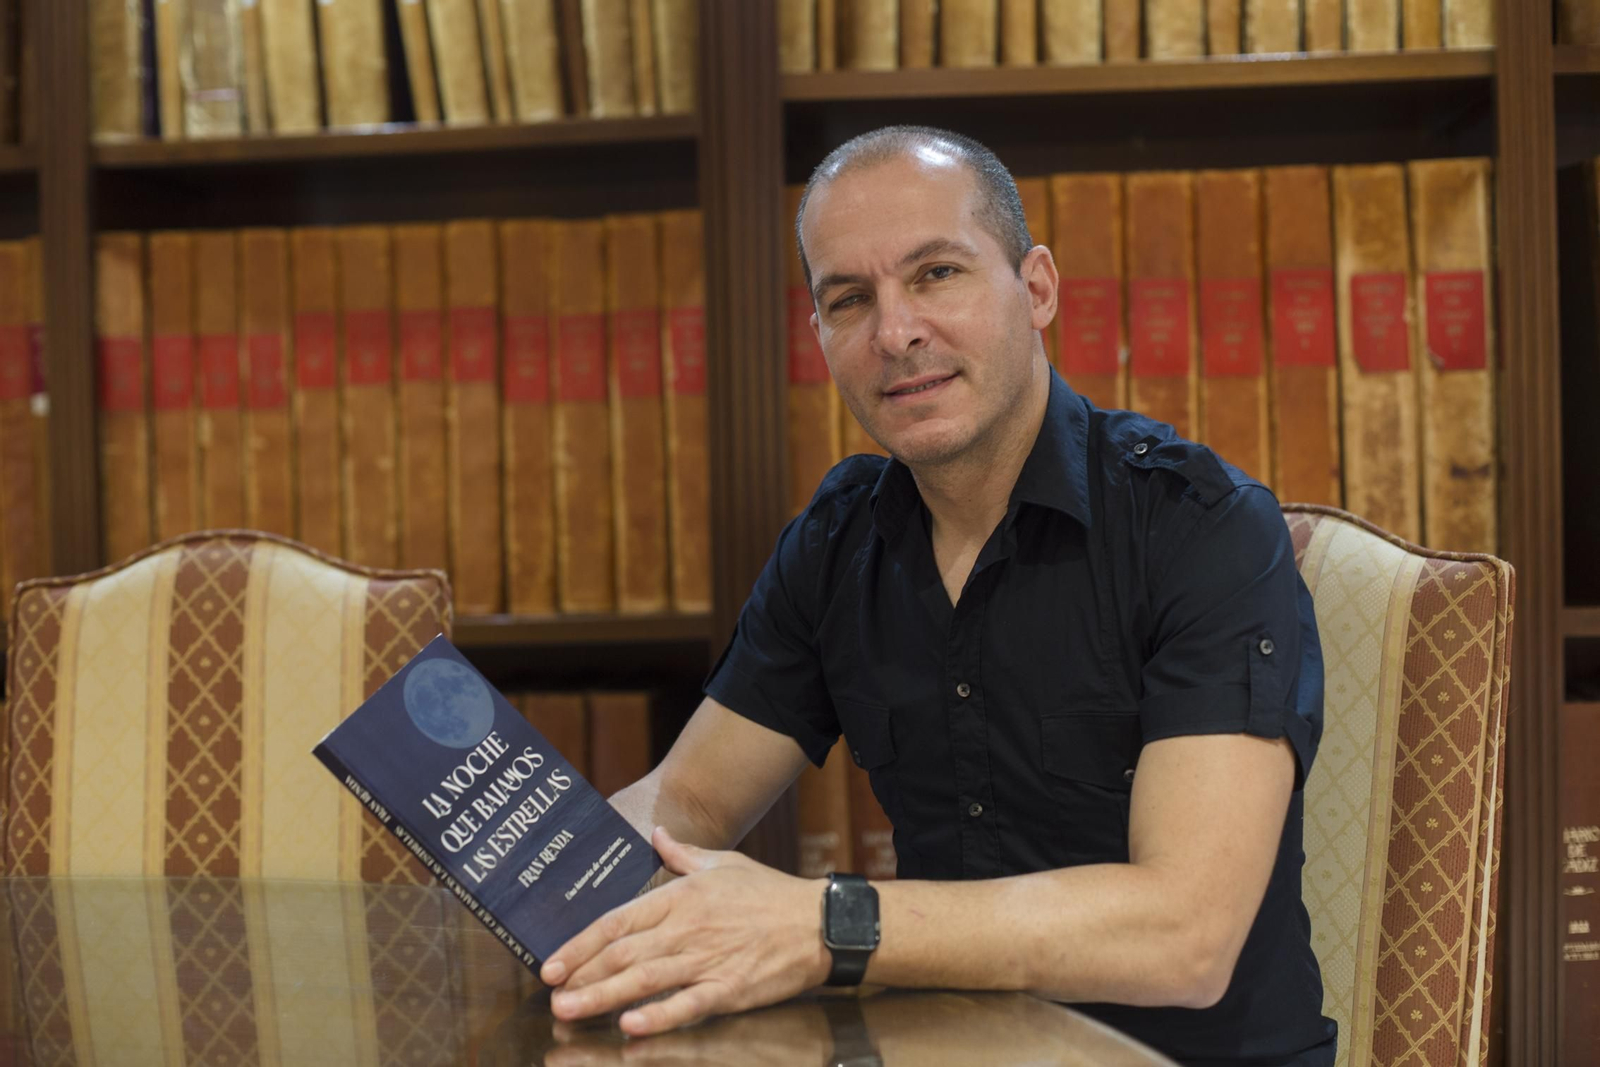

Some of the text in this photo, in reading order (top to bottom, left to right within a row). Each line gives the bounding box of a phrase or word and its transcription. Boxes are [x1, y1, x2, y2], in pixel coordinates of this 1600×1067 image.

[422, 731, 509, 819] LA NOCHE
[368, 800, 391, 823] FRAN
[441, 746, 544, 852] QUE BAJAMOS
[463, 769, 571, 883] LAS ESTRELLAS
[518, 830, 574, 888] FRAN RENDA
[618, 843, 632, 859] verso
[432, 863, 448, 880] LAS
[565, 888, 578, 900] Una
[574, 869, 594, 890] historia
[522, 952, 534, 965] LA
